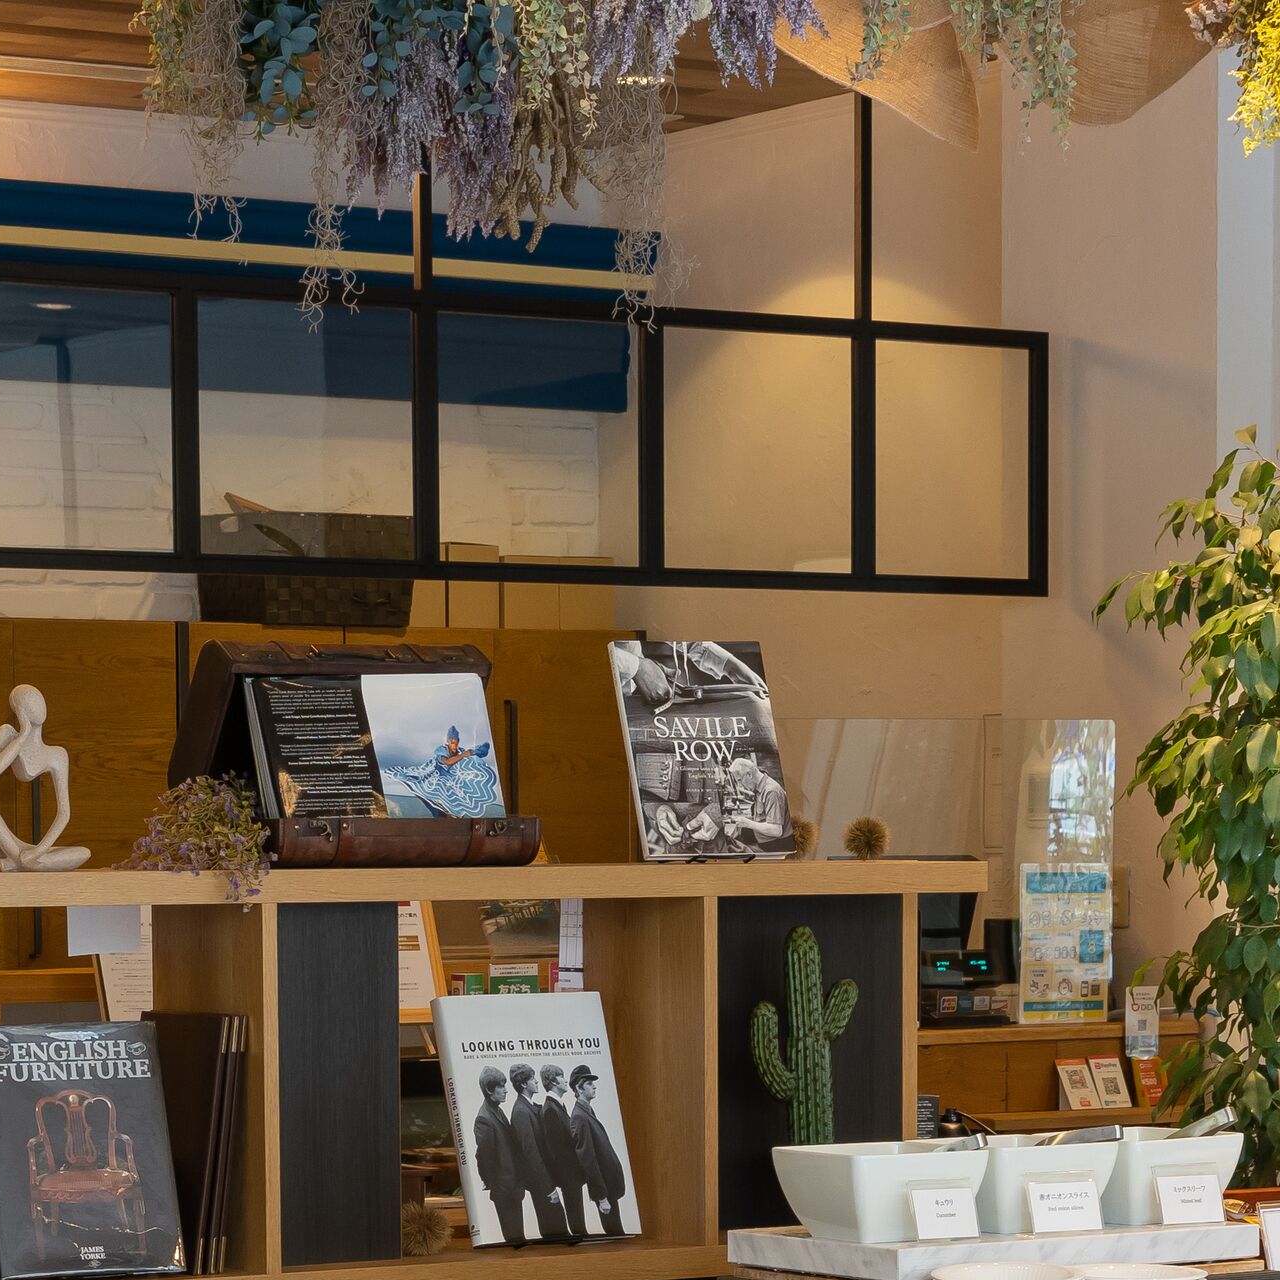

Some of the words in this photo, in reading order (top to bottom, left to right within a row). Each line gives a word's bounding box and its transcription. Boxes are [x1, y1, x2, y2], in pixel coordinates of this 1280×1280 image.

[653, 716, 751, 738] SAVILE
[672, 740, 737, 762] ROW
[10, 1039, 128, 1062] ENGLISH
[461, 1040, 515, 1053] LOOKING
[518, 1038, 574, 1051] THROUGH
[577, 1037, 600, 1049] YOU
[447, 1077, 458, 1110] LOOKING
[453, 1112, 465, 1148] THROUGH
[460, 1151, 468, 1166] YOU
[1039, 1191, 1090, 1201] 赤オニオンスライス
[1174, 1185, 1206, 1193] ミックスリーフ
[79, 1252, 107, 1260] YORKE
[80, 1245, 105, 1254] JAMES
